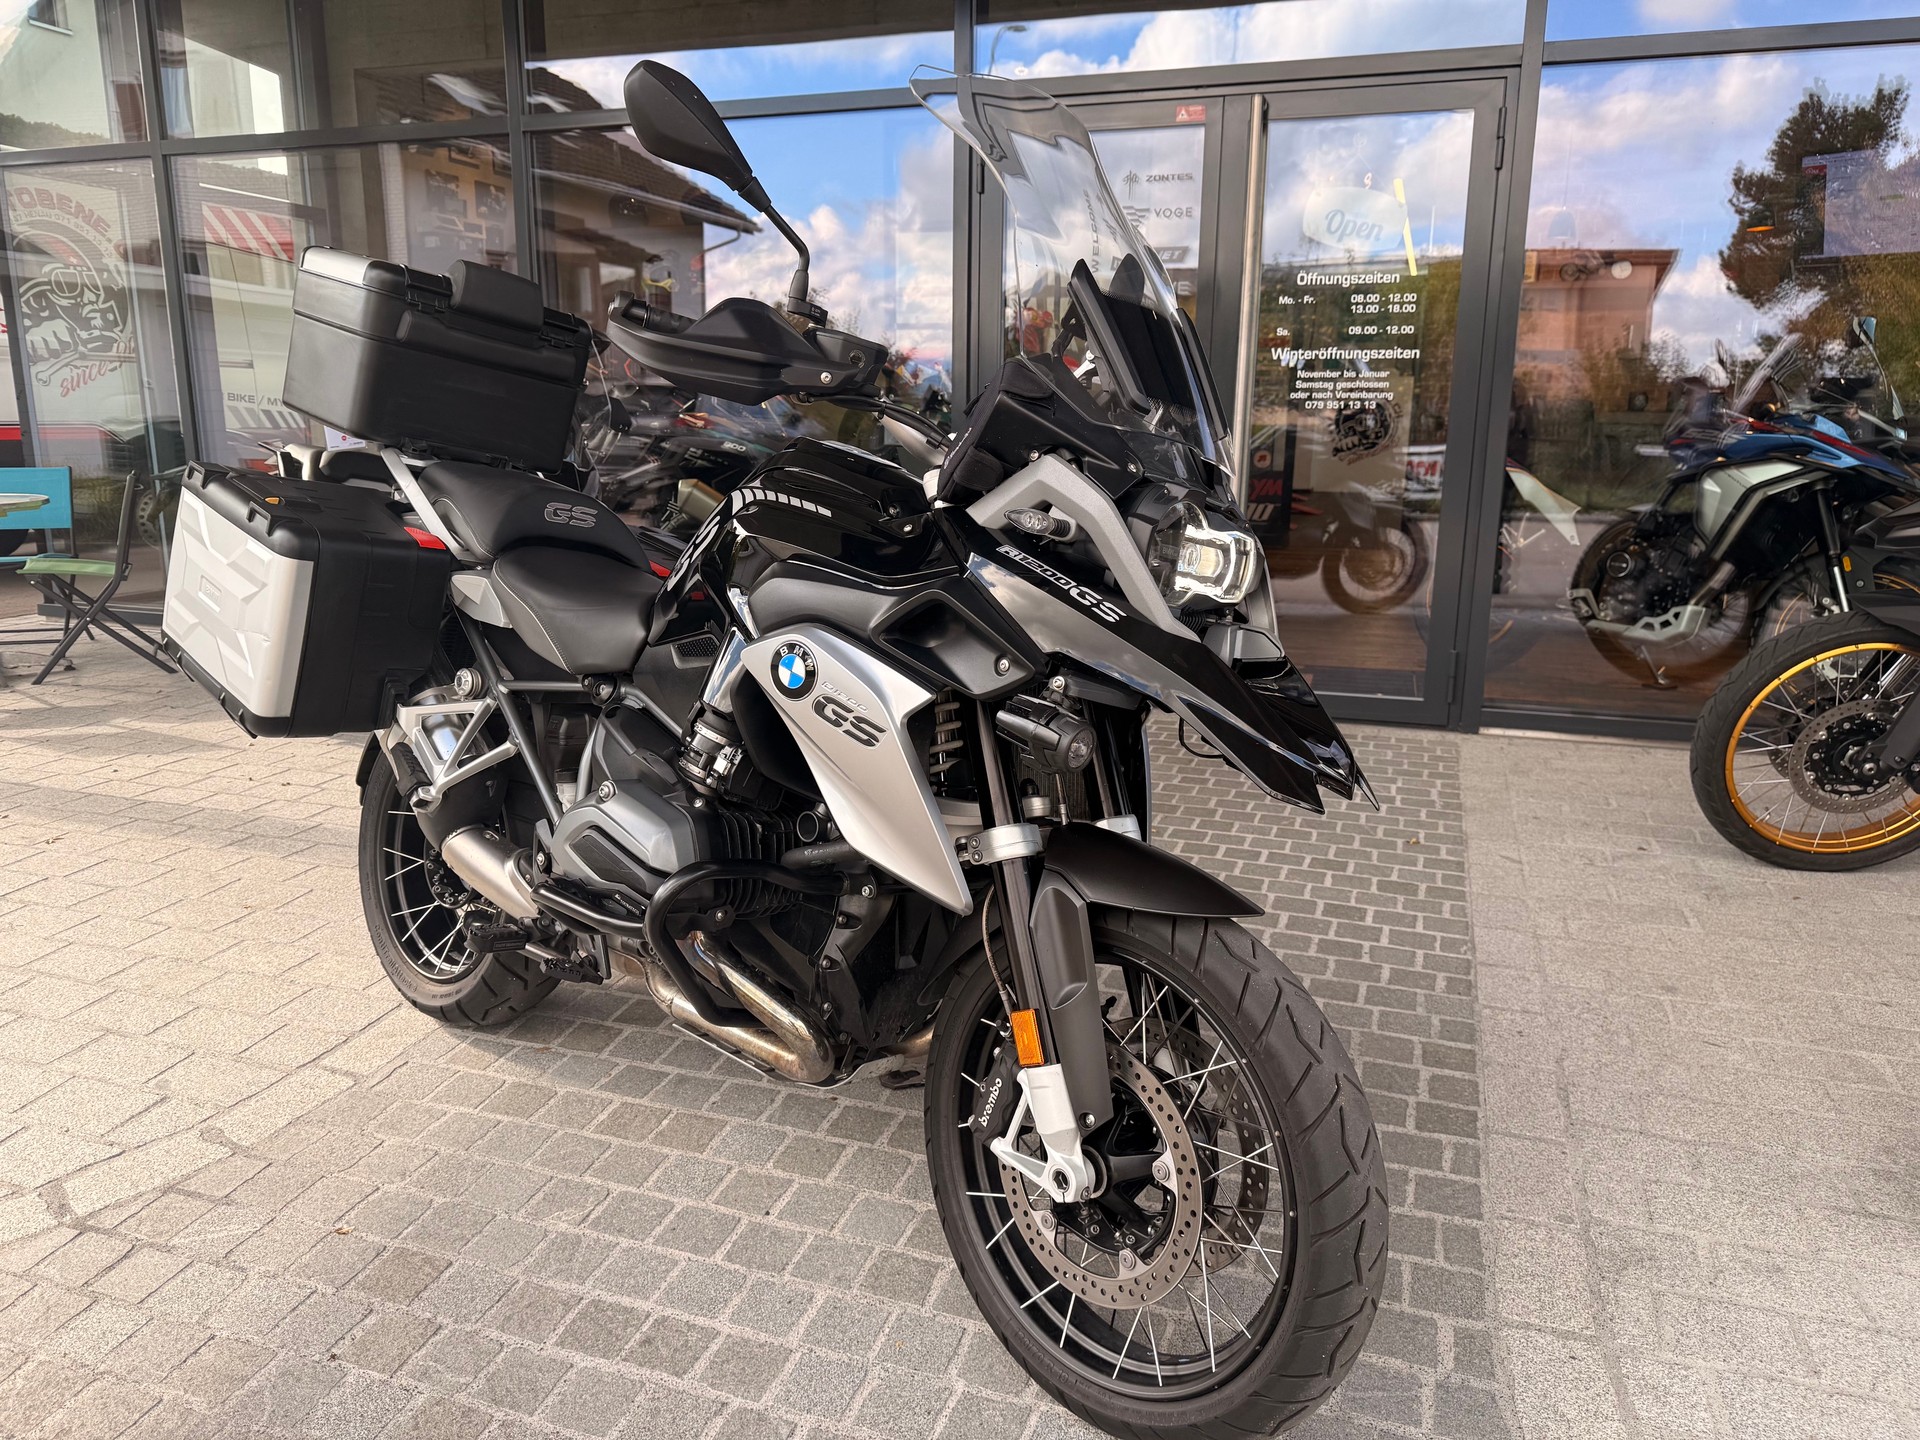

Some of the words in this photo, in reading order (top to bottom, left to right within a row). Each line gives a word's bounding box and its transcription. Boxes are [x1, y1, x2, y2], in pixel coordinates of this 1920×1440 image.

[1145, 173, 1194, 183] ZONTES
[1154, 206, 1193, 219] VOGE
[1082, 188, 1100, 274] WELCOME
[1325, 209, 1384, 243] Open
[1296, 270, 1400, 287] Öffnungszeiten
[1278, 295, 1295, 305] Mo.
[1303, 295, 1316, 304] Fr.
[1350, 293, 1380, 303] 08.00
[1388, 293, 1417, 303] 12.00
[1350, 304, 1379, 314] 13.00
[1387, 304, 1416, 313] 18.00
[1276, 327, 1291, 337] Sa.
[1348, 326, 1378, 335] 09.00
[1385, 325, 1415, 335] 12.00
[1270, 346, 1420, 362] Winteröffnungszeiten
[1296, 370, 1341, 379] November
[1343, 369, 1356, 378] bis
[1358, 370, 1390, 379] Januar
[1295, 380, 1334, 390] Samstag
[1335, 380, 1390, 390] geschlossen
[227, 392, 256, 404] BIKE
[1289, 390, 1310, 399] oder
[1311, 390, 1333, 399] nach
[1335, 390, 1394, 400] Vereinbarung
[1304, 400, 1324, 410] 079
[1326, 400, 1345, 410] 951
[1348, 400, 1361, 410] 13
[1363, 400, 1377, 410] 13
[544, 502, 598, 528] GS
[779, 644, 815, 671] BMW
[812, 694, 888, 748] GS
[978, 1077, 1003, 1128] brembo
